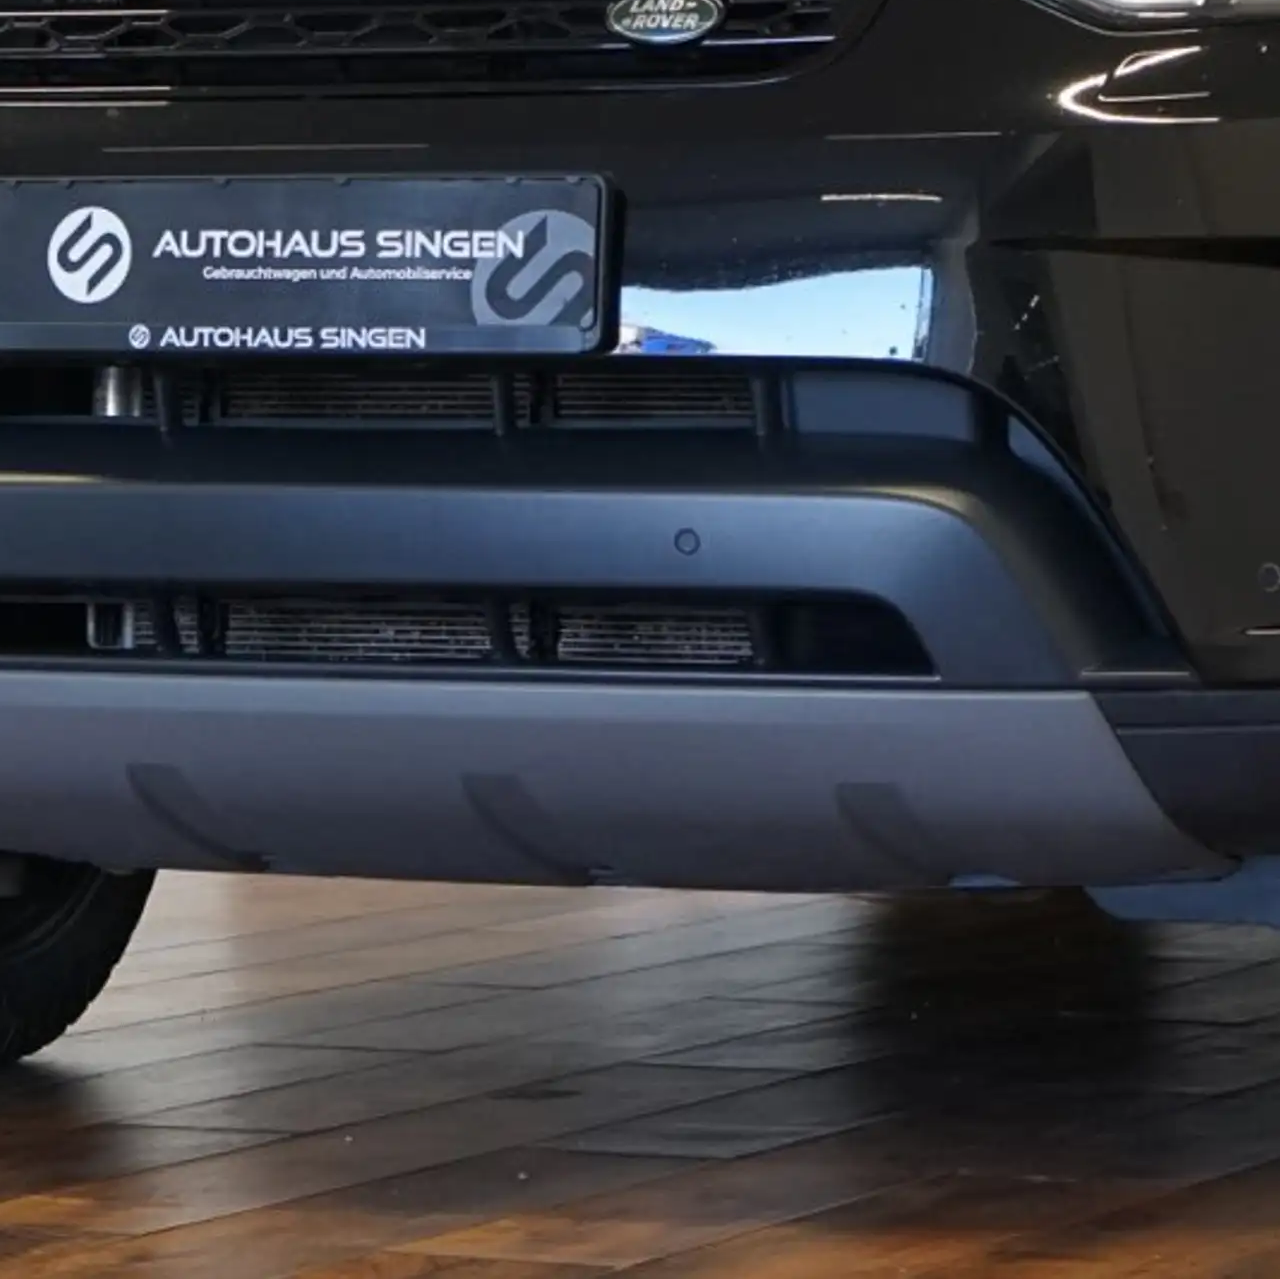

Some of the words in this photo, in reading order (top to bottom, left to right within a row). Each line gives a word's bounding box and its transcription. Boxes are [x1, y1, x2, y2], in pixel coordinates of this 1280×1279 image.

[152, 230, 367, 259] AUTOHAUS
[376, 230, 525, 259] SINGEN
[202, 266, 317, 283] Gebrauchtwagen
[320, 266, 347, 281] und
[350, 266, 473, 282] Automobilservice
[159, 327, 313, 348] AUTOHAUS
[321, 328, 426, 348] SINGEN
